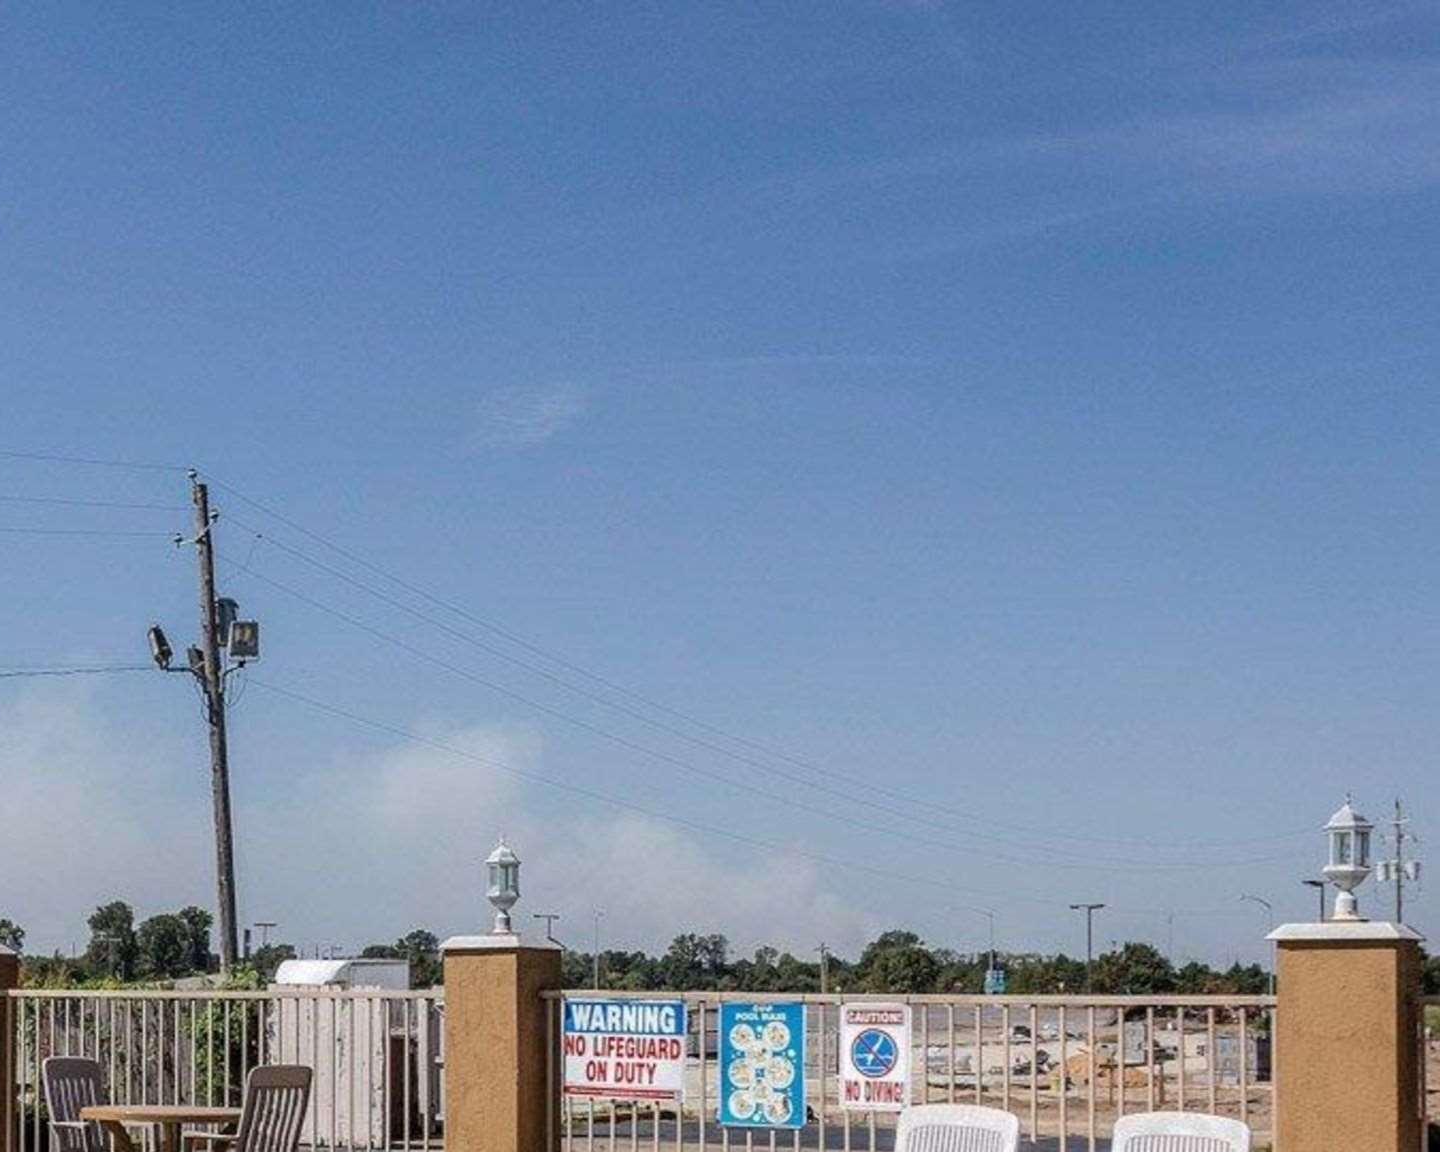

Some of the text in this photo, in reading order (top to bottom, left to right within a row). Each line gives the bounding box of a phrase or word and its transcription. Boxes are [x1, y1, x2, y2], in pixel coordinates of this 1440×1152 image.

[571, 1004, 676, 1033] WARNING
[563, 1035, 680, 1059] NO LIFEGUARD
[586, 1061, 656, 1084] ON DUTY
[845, 1080, 860, 1101] NO
